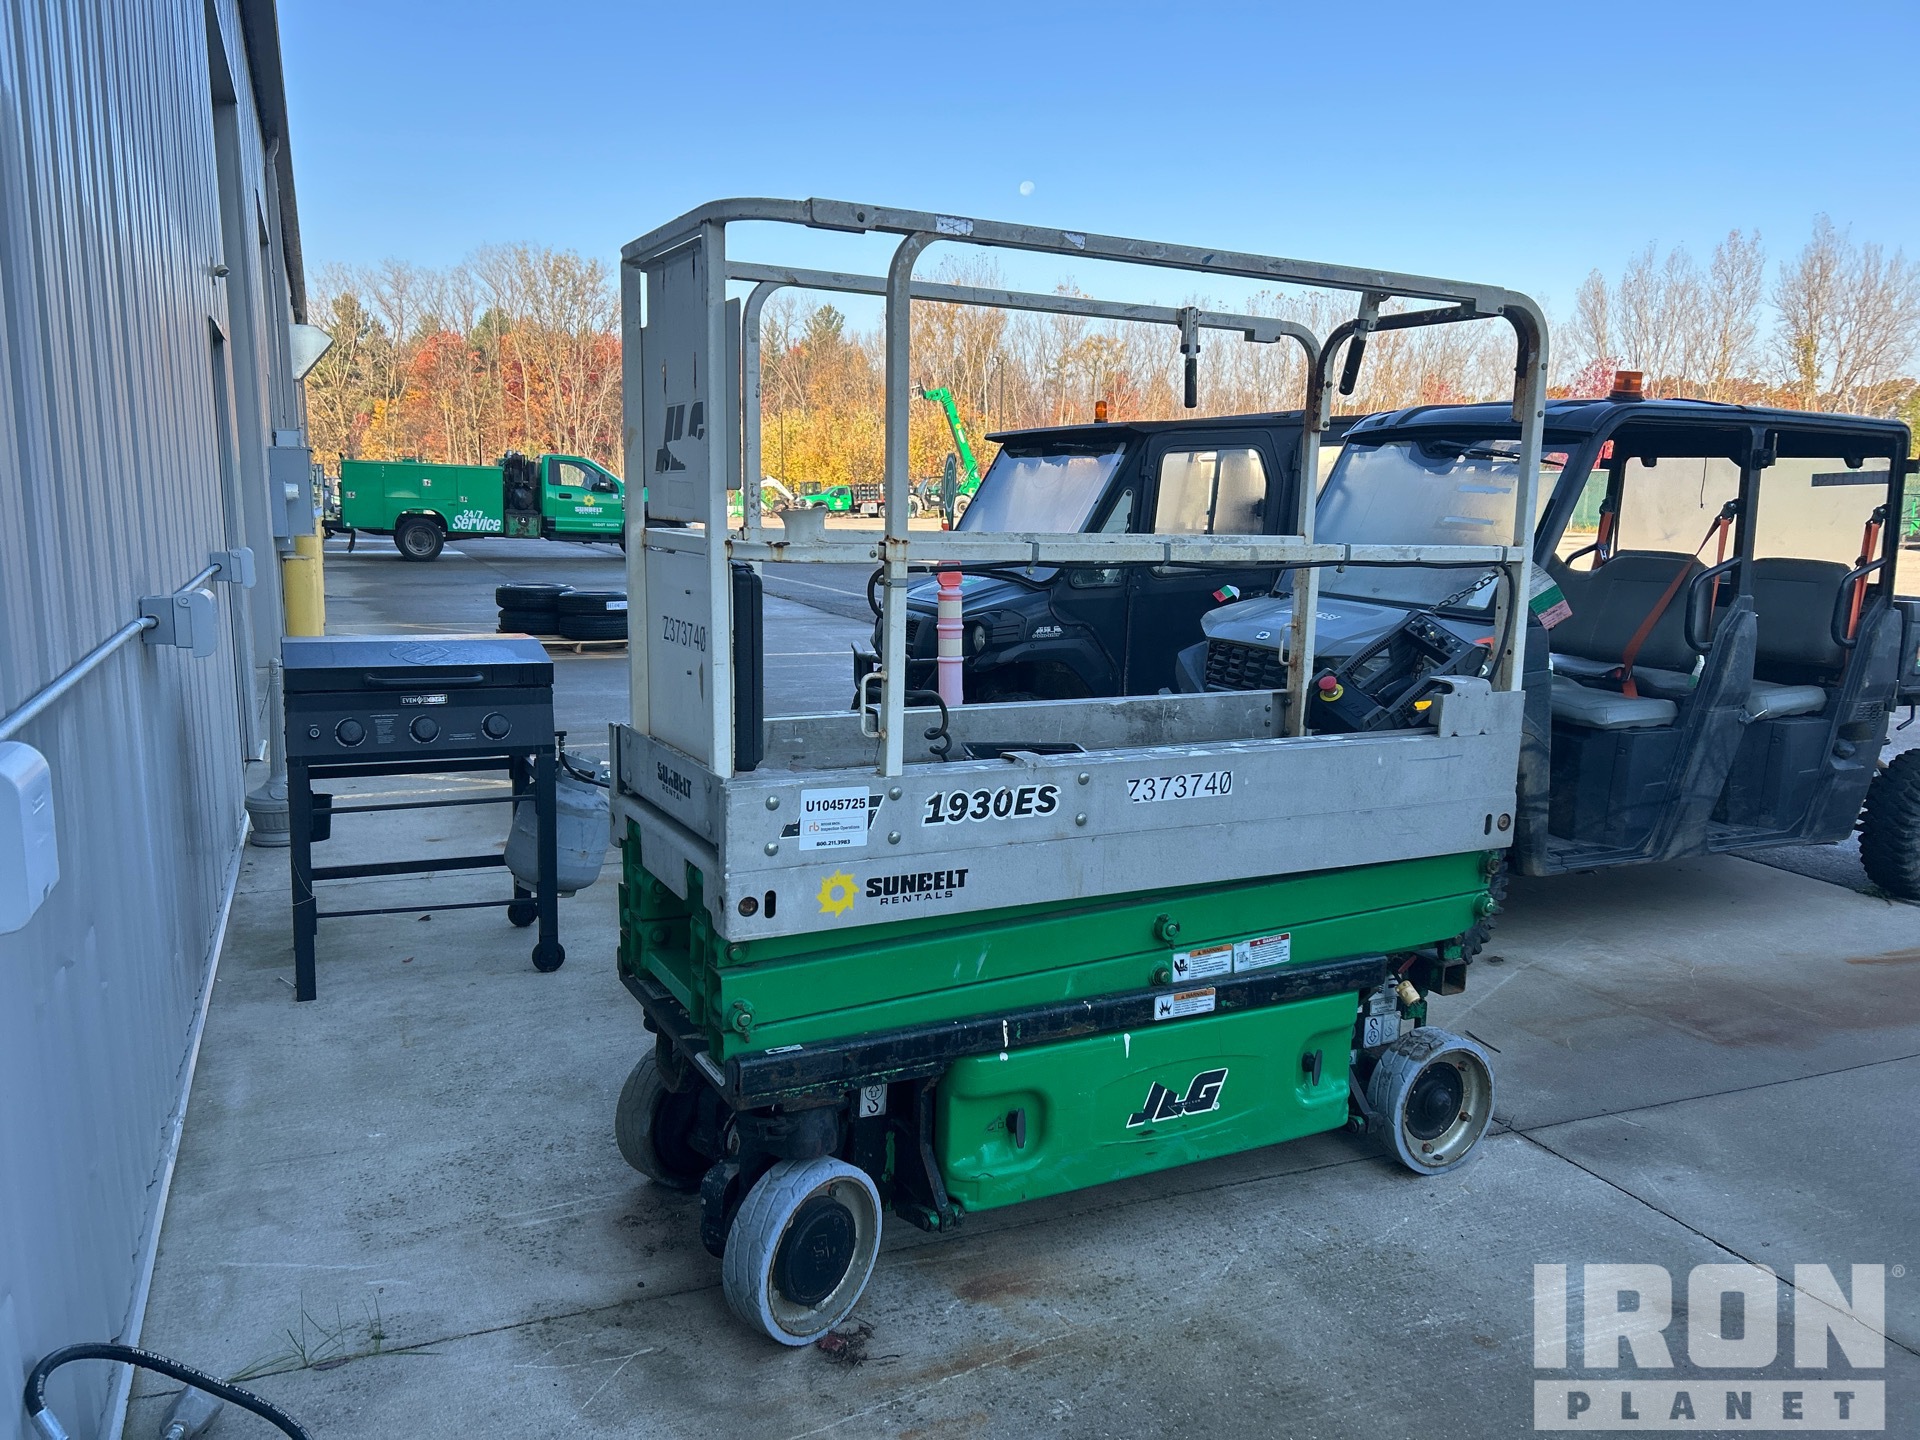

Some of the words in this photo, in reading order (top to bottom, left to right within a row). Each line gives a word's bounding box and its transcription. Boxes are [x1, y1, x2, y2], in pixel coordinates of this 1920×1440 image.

[463, 509, 484, 518] 24/7
[574, 506, 603, 514] SUNBELT
[452, 515, 501, 531] Service
[662, 615, 706, 652] Z373740
[402, 696, 417, 704] EVEN
[1127, 771, 1232, 802] Z373740
[806, 798, 866, 812] U1045725
[923, 785, 1059, 825] 1930ES
[866, 868, 969, 898] SUNBELT
[880, 890, 953, 905] RENTALS
[1262, 935, 1282, 945] DANGER
[1202, 946, 1224, 954] WARNING
[1185, 990, 1208, 999] WARNING
